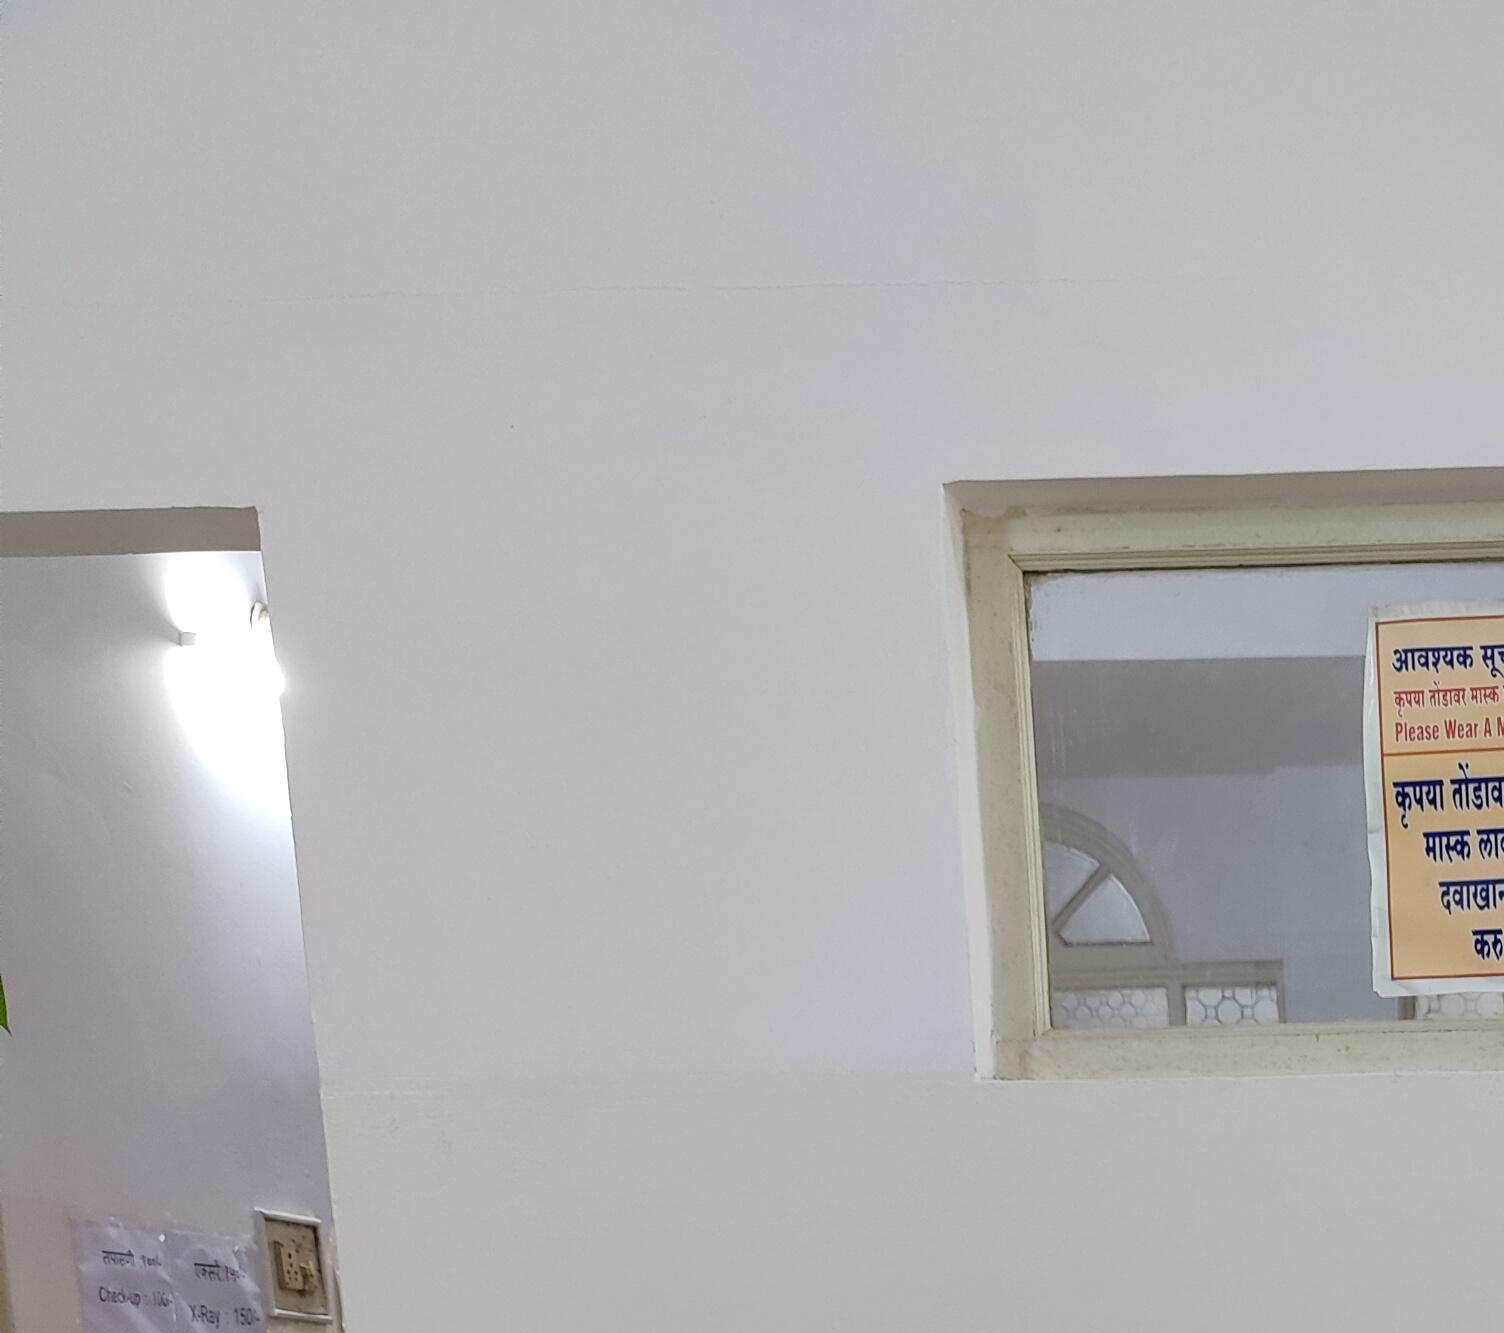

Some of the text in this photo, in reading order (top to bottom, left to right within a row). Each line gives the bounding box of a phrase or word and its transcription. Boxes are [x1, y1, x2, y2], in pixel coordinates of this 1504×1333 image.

[1392, 645, 1474, 674] आवश्यक
[1393, 690, 1425, 718] कृपया
[1428, 681, 1467, 707] तोंडावर
[1470, 685, 1500, 705] मास्क
[1394, 721, 1440, 743] Please
[1444, 718, 1479, 740] Wear
[1483, 717, 1493, 738] A
[1392, 779, 1444, 830] कृपया
[1422, 829, 1471, 864] मास्क
